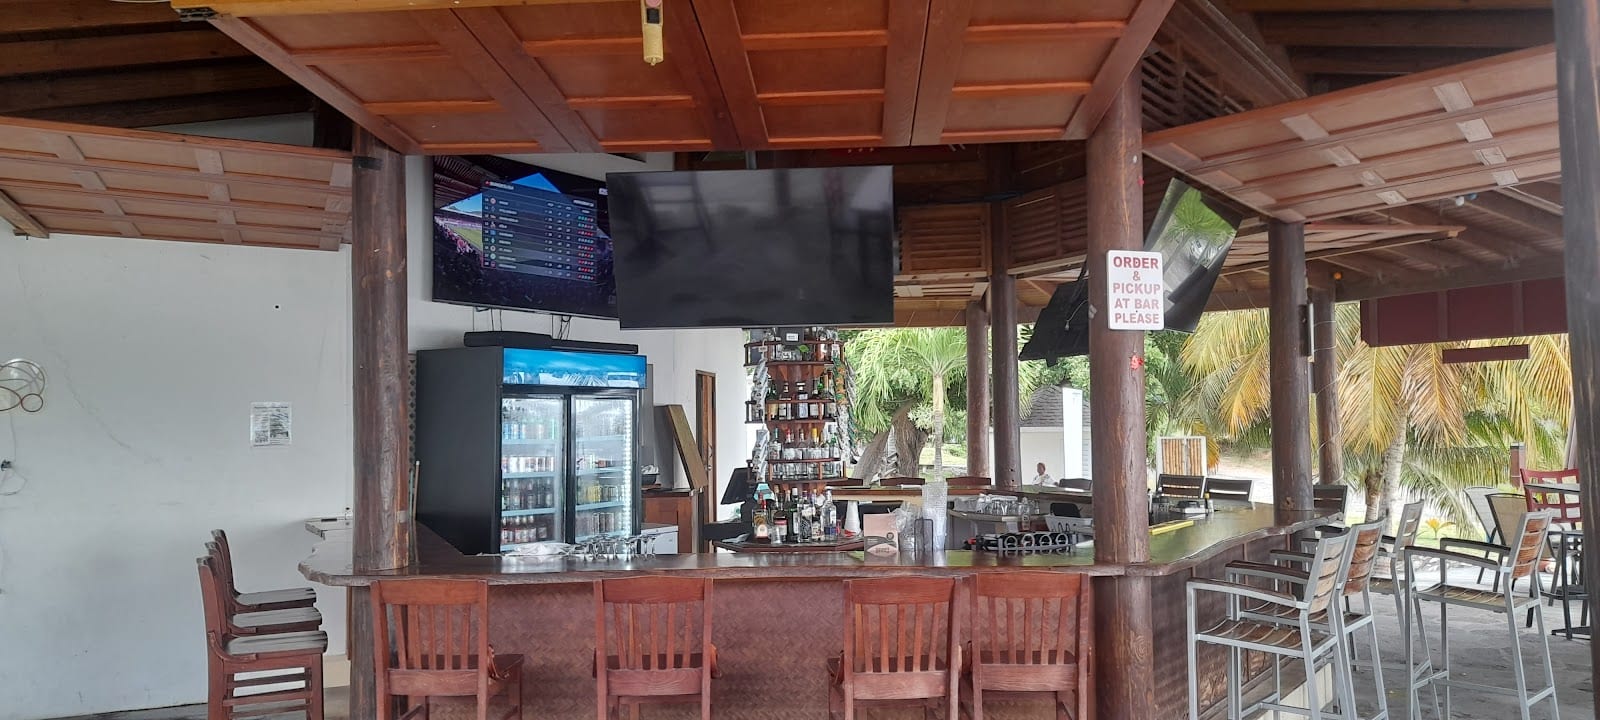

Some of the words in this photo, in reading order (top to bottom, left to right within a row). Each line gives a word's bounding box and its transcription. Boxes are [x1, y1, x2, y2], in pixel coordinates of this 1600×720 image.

[1113, 256, 1158, 269] ORDER
[1133, 271, 1140, 281] &
[1113, 283, 1160, 295] PICKUP
[1114, 298, 1130, 309] AT
[1135, 299, 1159, 309] BAR
[1115, 313, 1159, 324] PLEASE
